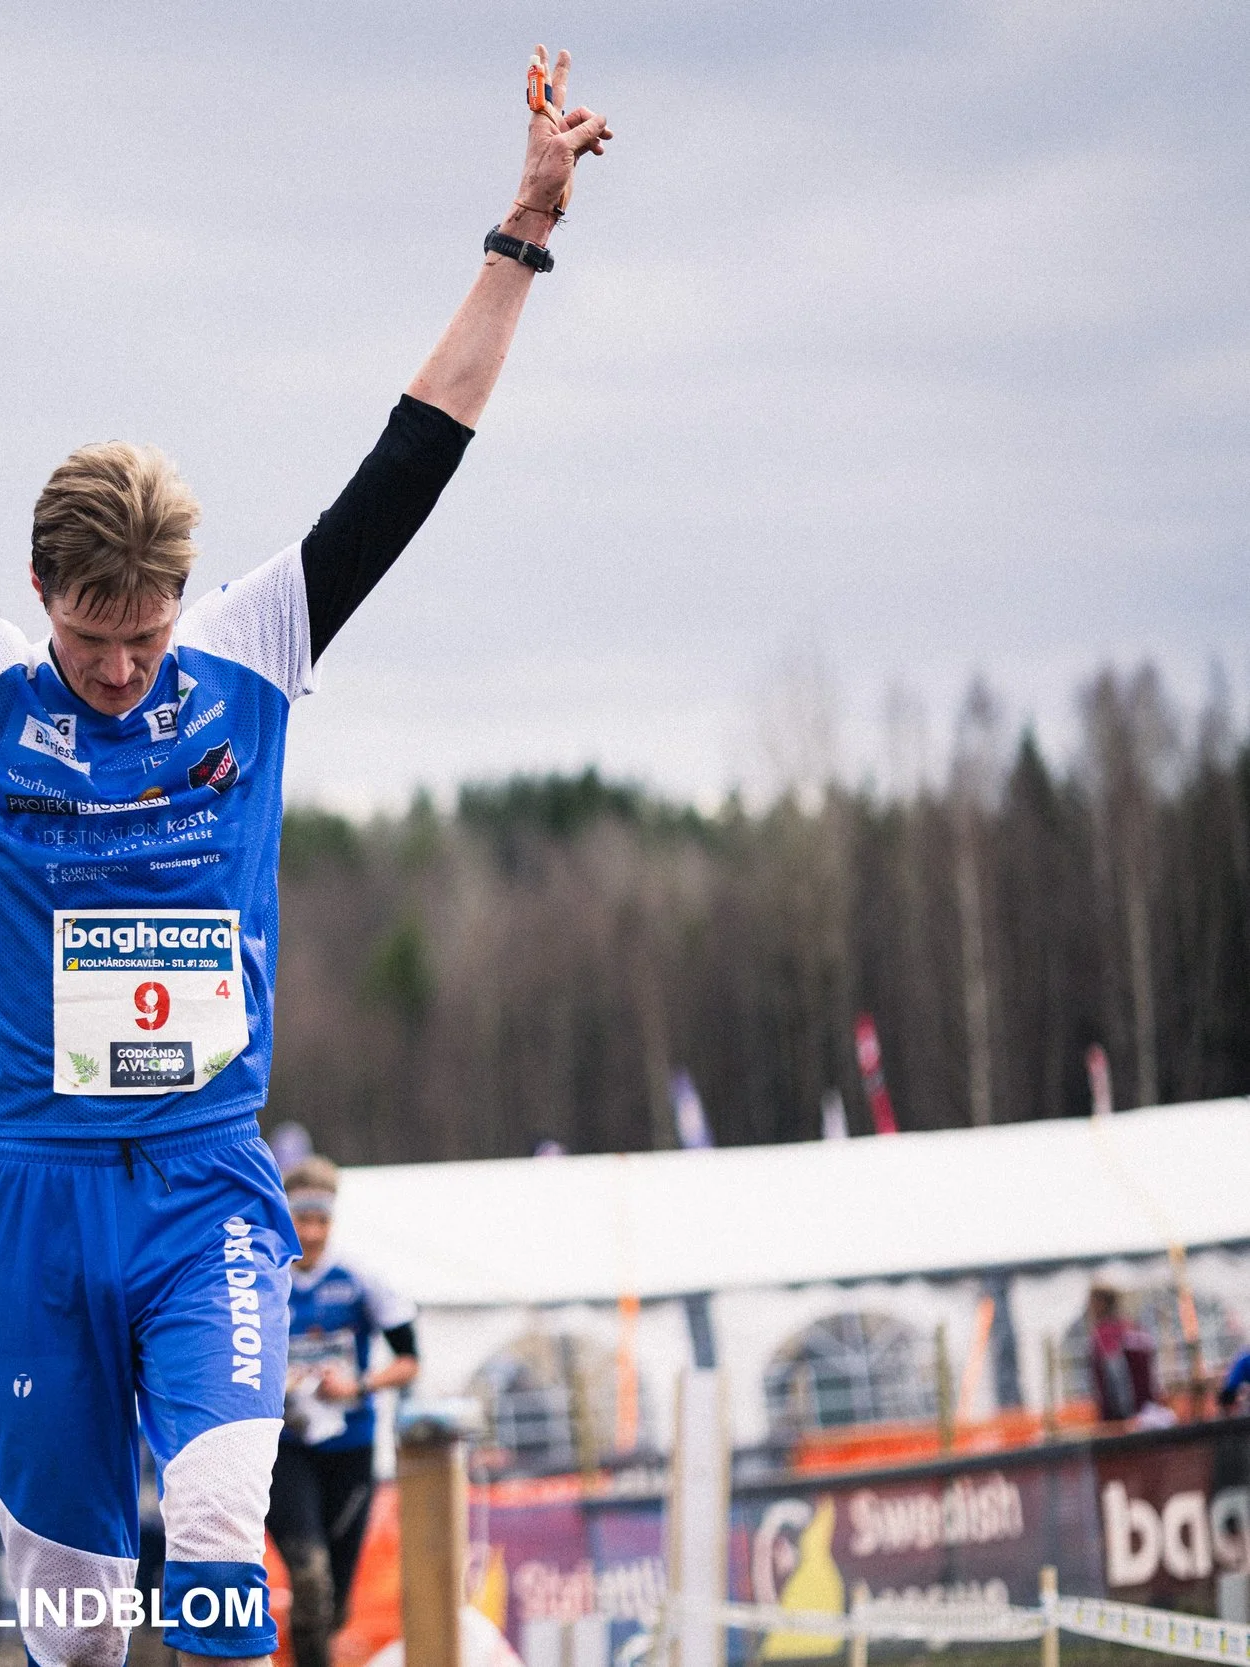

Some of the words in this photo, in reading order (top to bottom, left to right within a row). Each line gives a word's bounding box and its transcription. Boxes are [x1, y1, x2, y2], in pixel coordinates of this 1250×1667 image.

[184, 700, 227, 738] Blekinge
[9, 797, 74, 813] PROJEKT
[43, 822, 160, 846] DESTINATION
[166, 809, 219, 835] KOSTA
[202, 853, 221, 864] VVS
[61, 872, 108, 883] KOMMUN
[64, 921, 232, 953] bagheera
[80, 956, 165, 969] KOLMÅRDSKAVLEN
[171, 959, 187, 968] STL
[187, 959, 197, 968] #1
[198, 959, 219, 968] 2026
[215, 979, 231, 999] 4
[134, 981, 171, 1031] 9
[117, 1046, 185, 1059] GODKÄNDA
[116, 1058, 185, 1072] AVLOPP
[851, 1471, 1025, 1557] Swedish
